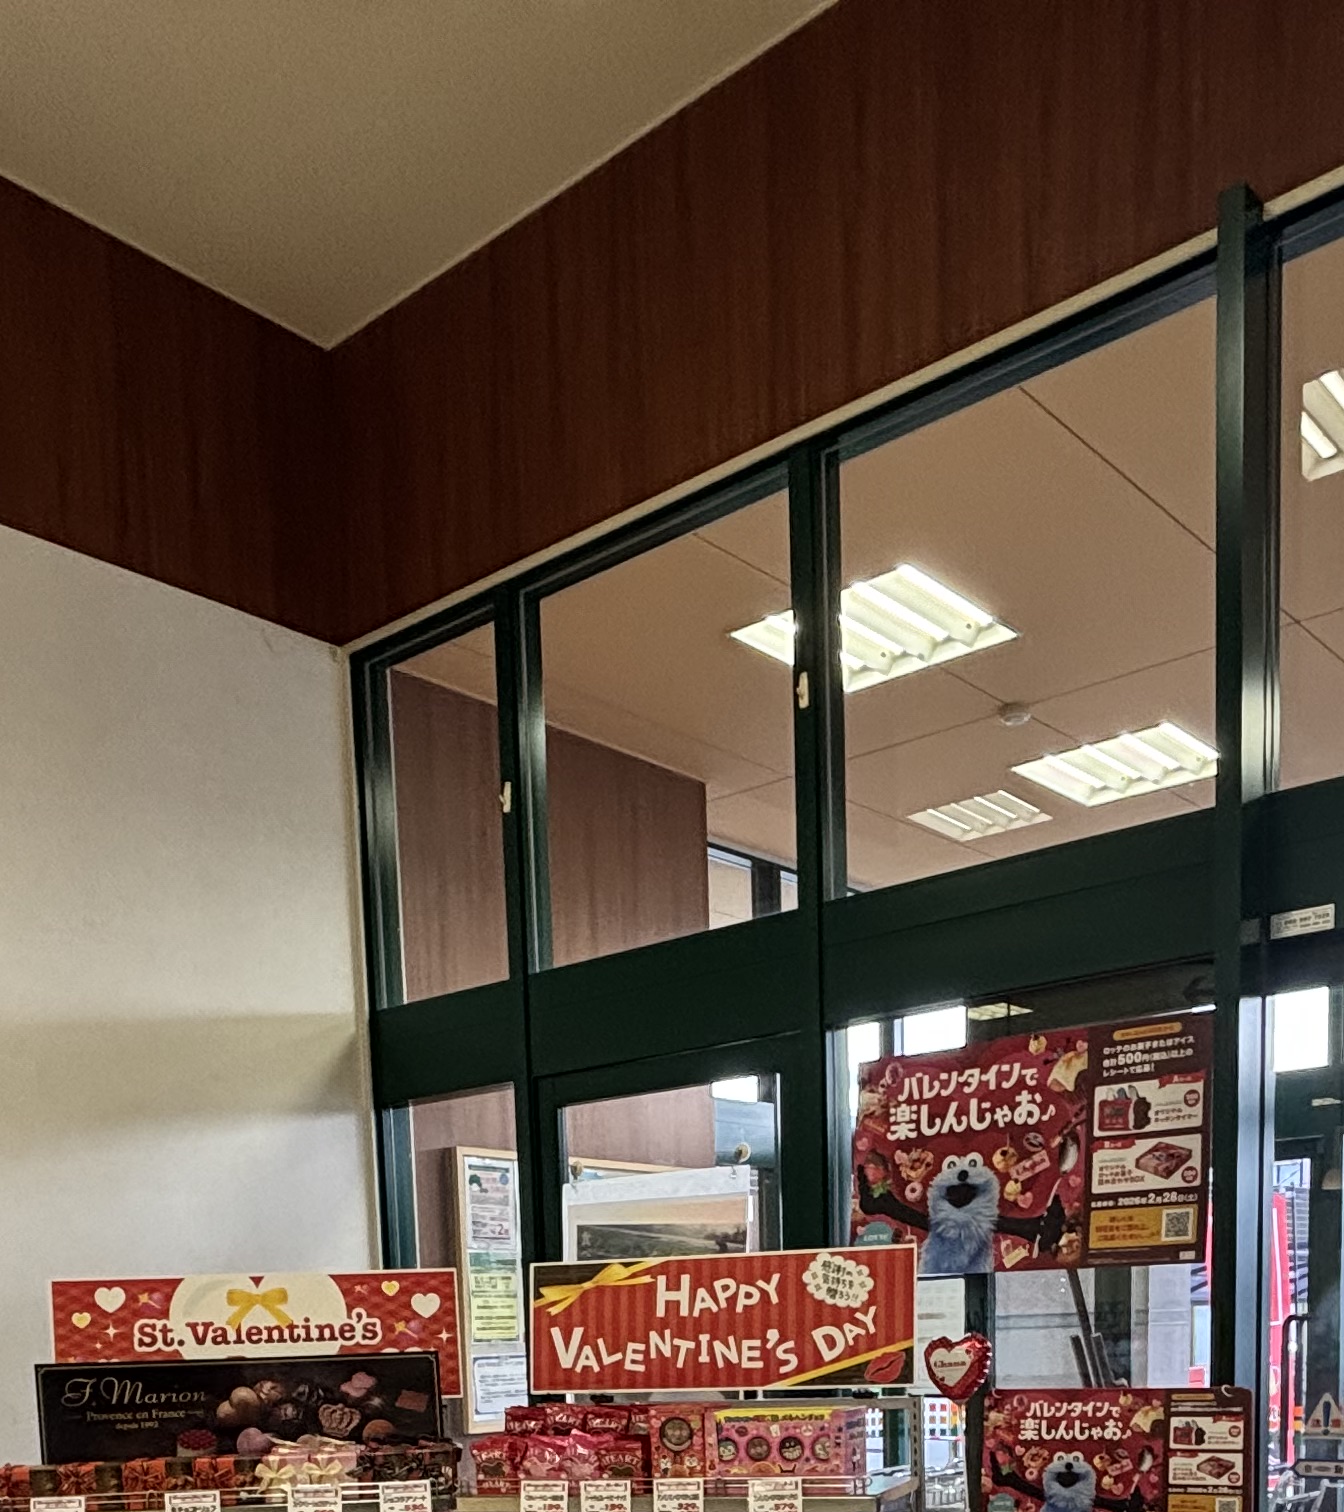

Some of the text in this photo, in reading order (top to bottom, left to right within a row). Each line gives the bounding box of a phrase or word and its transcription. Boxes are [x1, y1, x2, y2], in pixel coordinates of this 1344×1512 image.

[897, 1061, 1039, 1103] バレンタインで
[655, 1273, 782, 1318] HAPPY
[550, 1305, 878, 1374] VALENTINE'S DAY
[100, 1376, 207, 1406] Marion
[86, 1409, 186, 1422] Provence en France
[1025, 1401, 1120, 1419] バレンタインで
